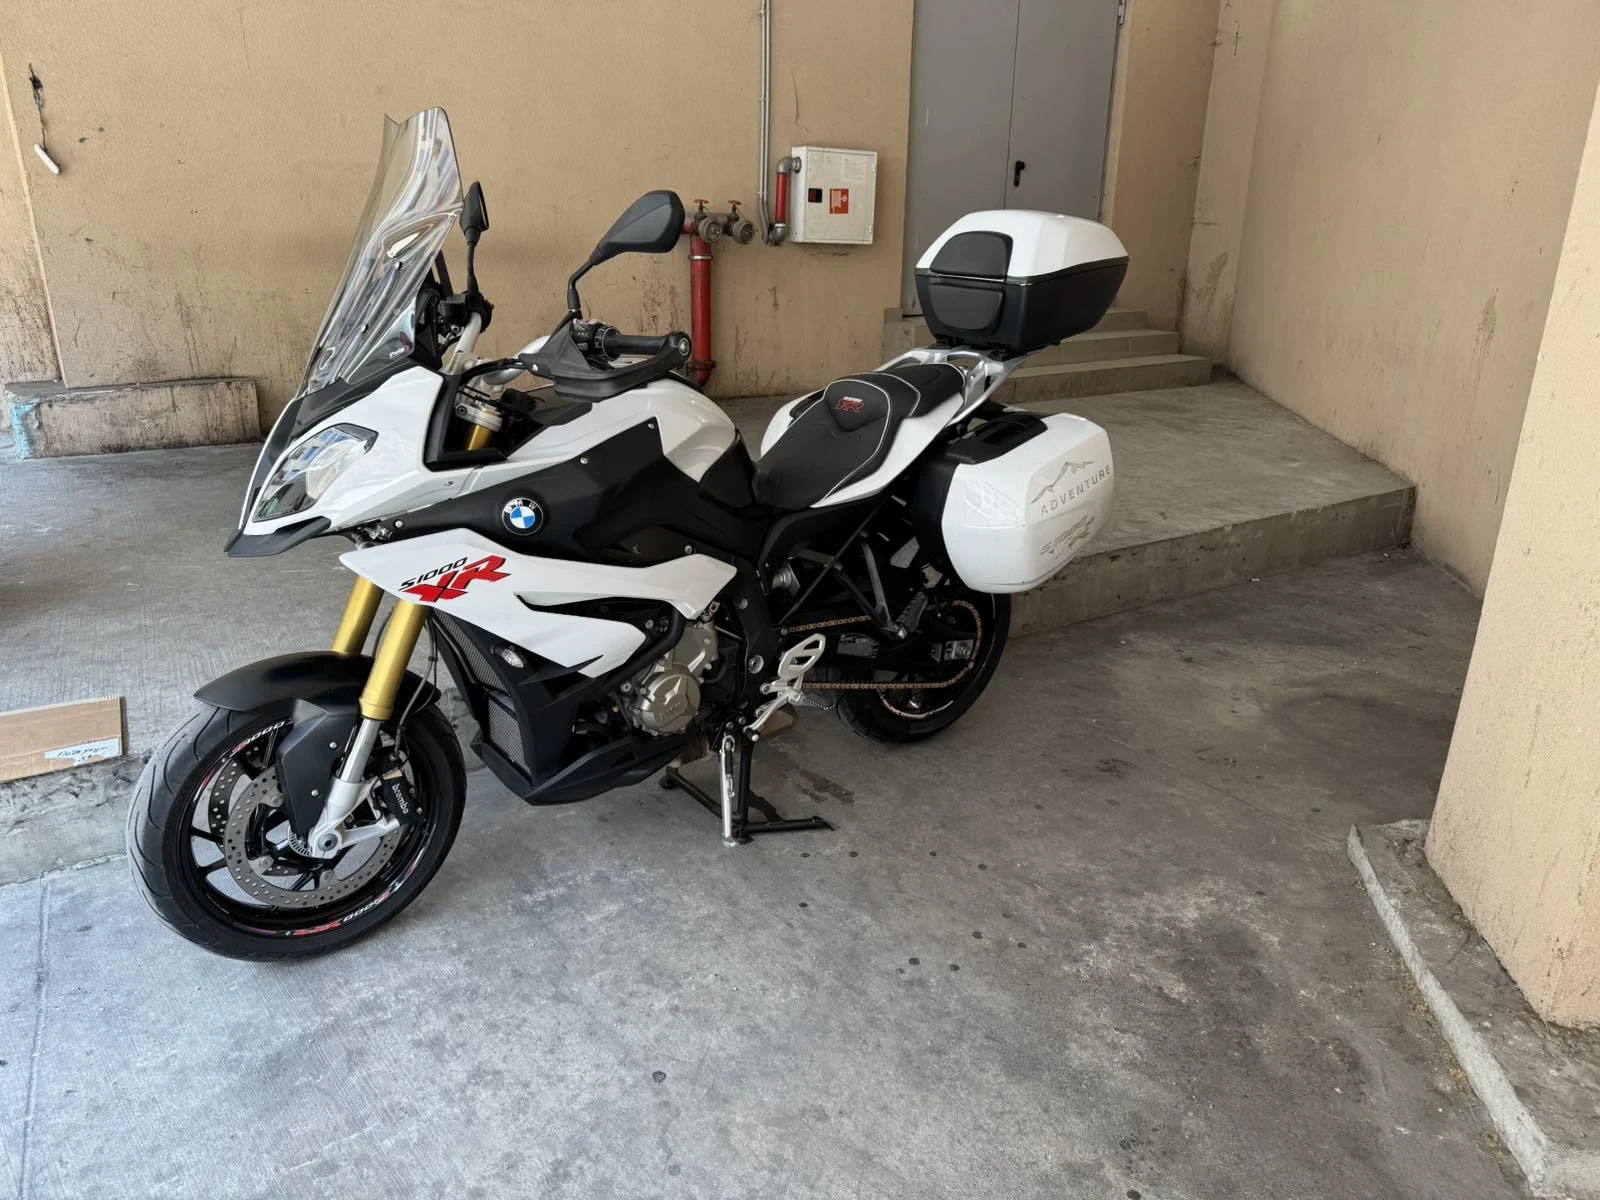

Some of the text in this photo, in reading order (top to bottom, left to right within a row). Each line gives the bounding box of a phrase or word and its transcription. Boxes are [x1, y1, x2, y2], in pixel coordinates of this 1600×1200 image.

[503, 499, 539, 514] BMW
[1040, 464, 1112, 516] ADVENTURE
[398, 557, 468, 592] S1000
[402, 555, 513, 603] XR
[391, 783, 409, 814] brembo
